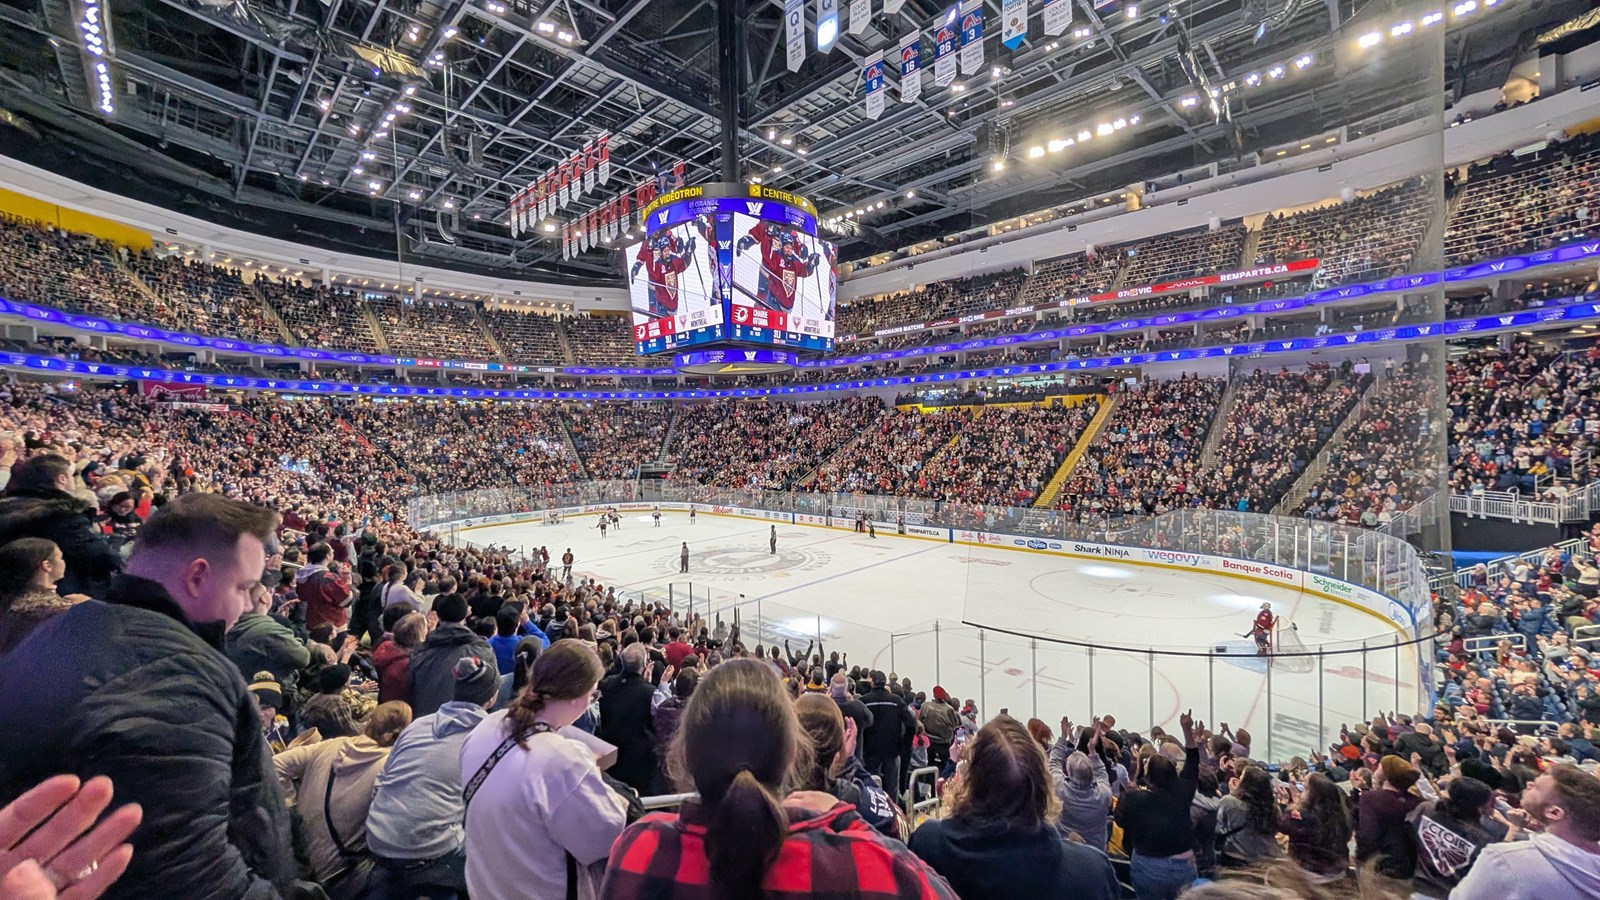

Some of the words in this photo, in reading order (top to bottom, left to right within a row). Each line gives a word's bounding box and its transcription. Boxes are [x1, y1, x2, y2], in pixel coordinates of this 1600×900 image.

[969, 28, 976, 40] 3
[939, 41, 951, 55] 26
[906, 60, 915, 73] 16
[872, 79, 877, 89] 8
[763, 187, 792, 203] CENTRE
[1220, 265, 1288, 282] REMPARTS.CA
[1138, 287, 1152, 295] VIC
[908, 528, 940, 537] REMPARTS.CA
[1074, 544, 1102, 555] Shark
[1148, 550, 1201, 566] wegovy
[1223, 560, 1262, 574] Banque
[1263, 566, 1293, 580] Scotia
[1313, 576, 1353, 594] Schneider
